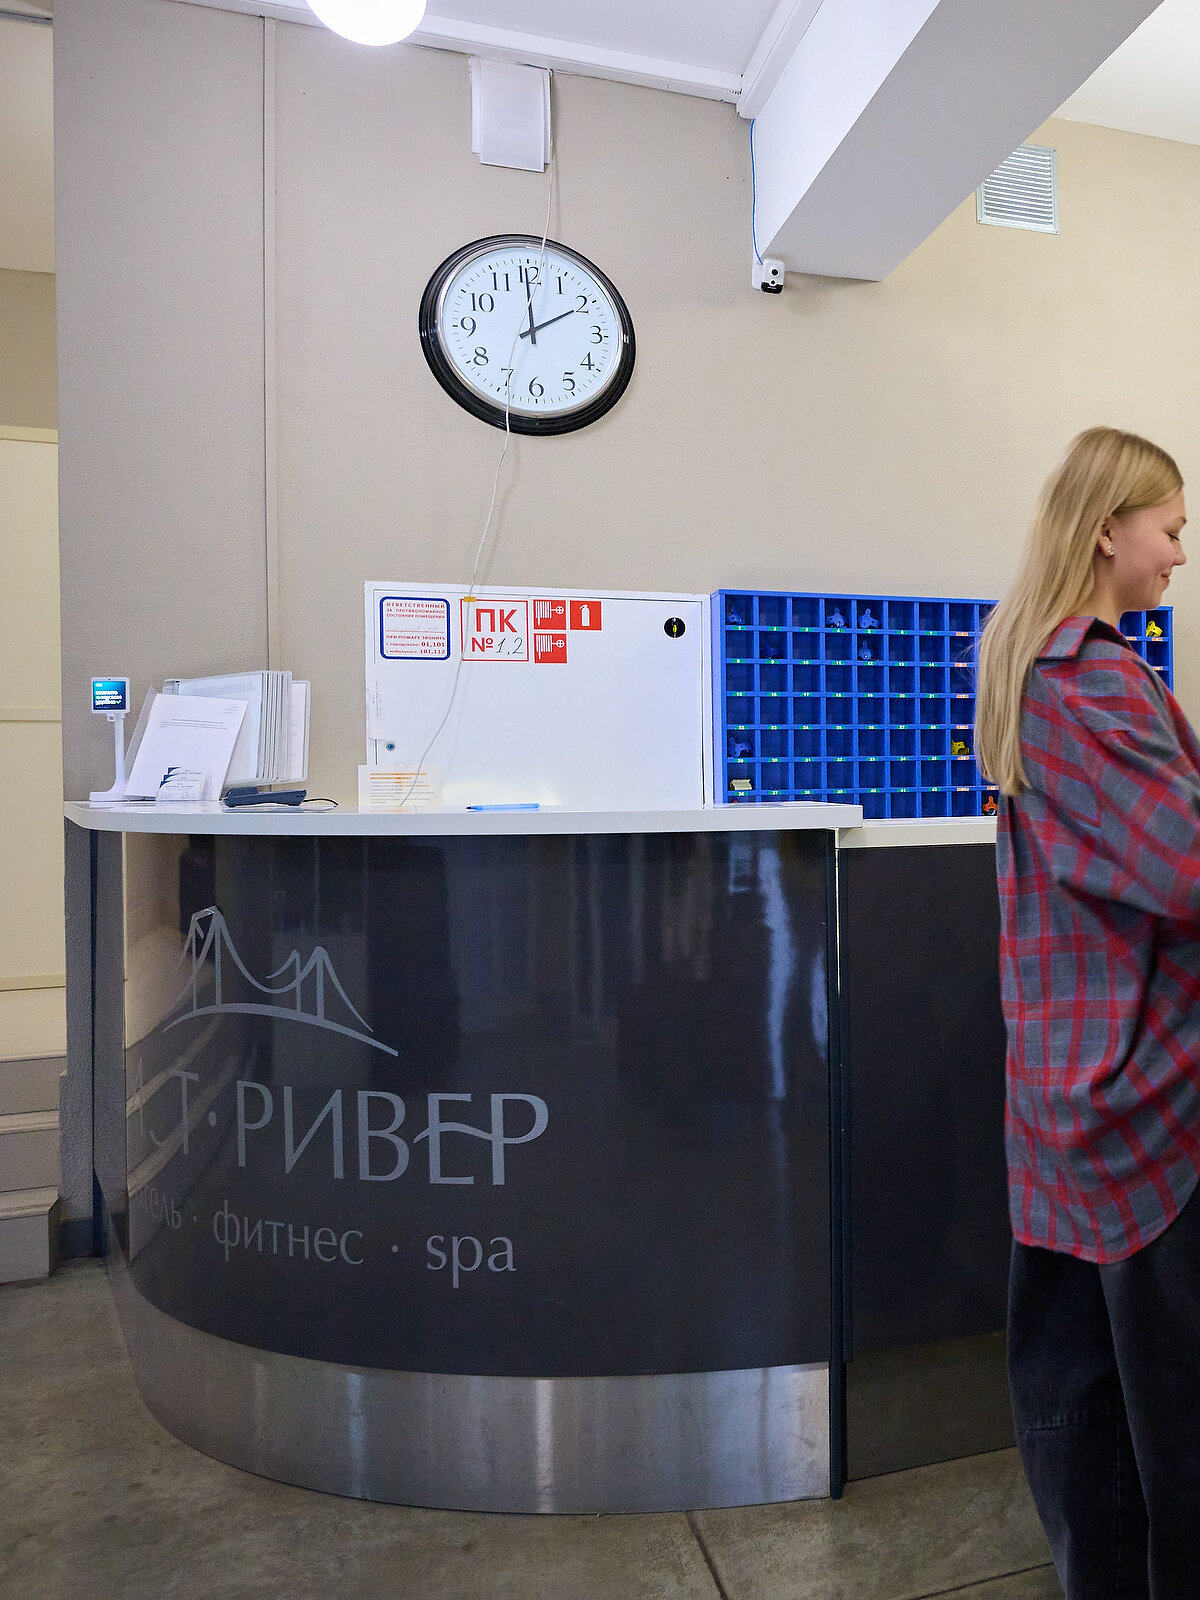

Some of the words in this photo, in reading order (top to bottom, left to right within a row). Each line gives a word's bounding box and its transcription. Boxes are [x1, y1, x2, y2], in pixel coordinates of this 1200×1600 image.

[492, 272, 512, 292] 11
[518, 265, 542, 286] 12
[556, 276, 564, 295] 1
[470, 292, 495, 313] 10
[575, 295, 589, 314] 2
[460, 316, 477, 338] 9
[589, 325, 603, 344] 3
[472, 346, 489, 366] 8
[580, 351, 595, 371] 4
[501, 368, 514, 387] 7
[528, 376, 544, 397] 6
[562, 371, 576, 392] 5
[476, 608, 518, 632] ПК
[472, 637, 493, 652] №
[236, 1080, 550, 1186] РИВЕР
[212, 1200, 364, 1265] фитнес
[426, 1233, 518, 1289] spa
